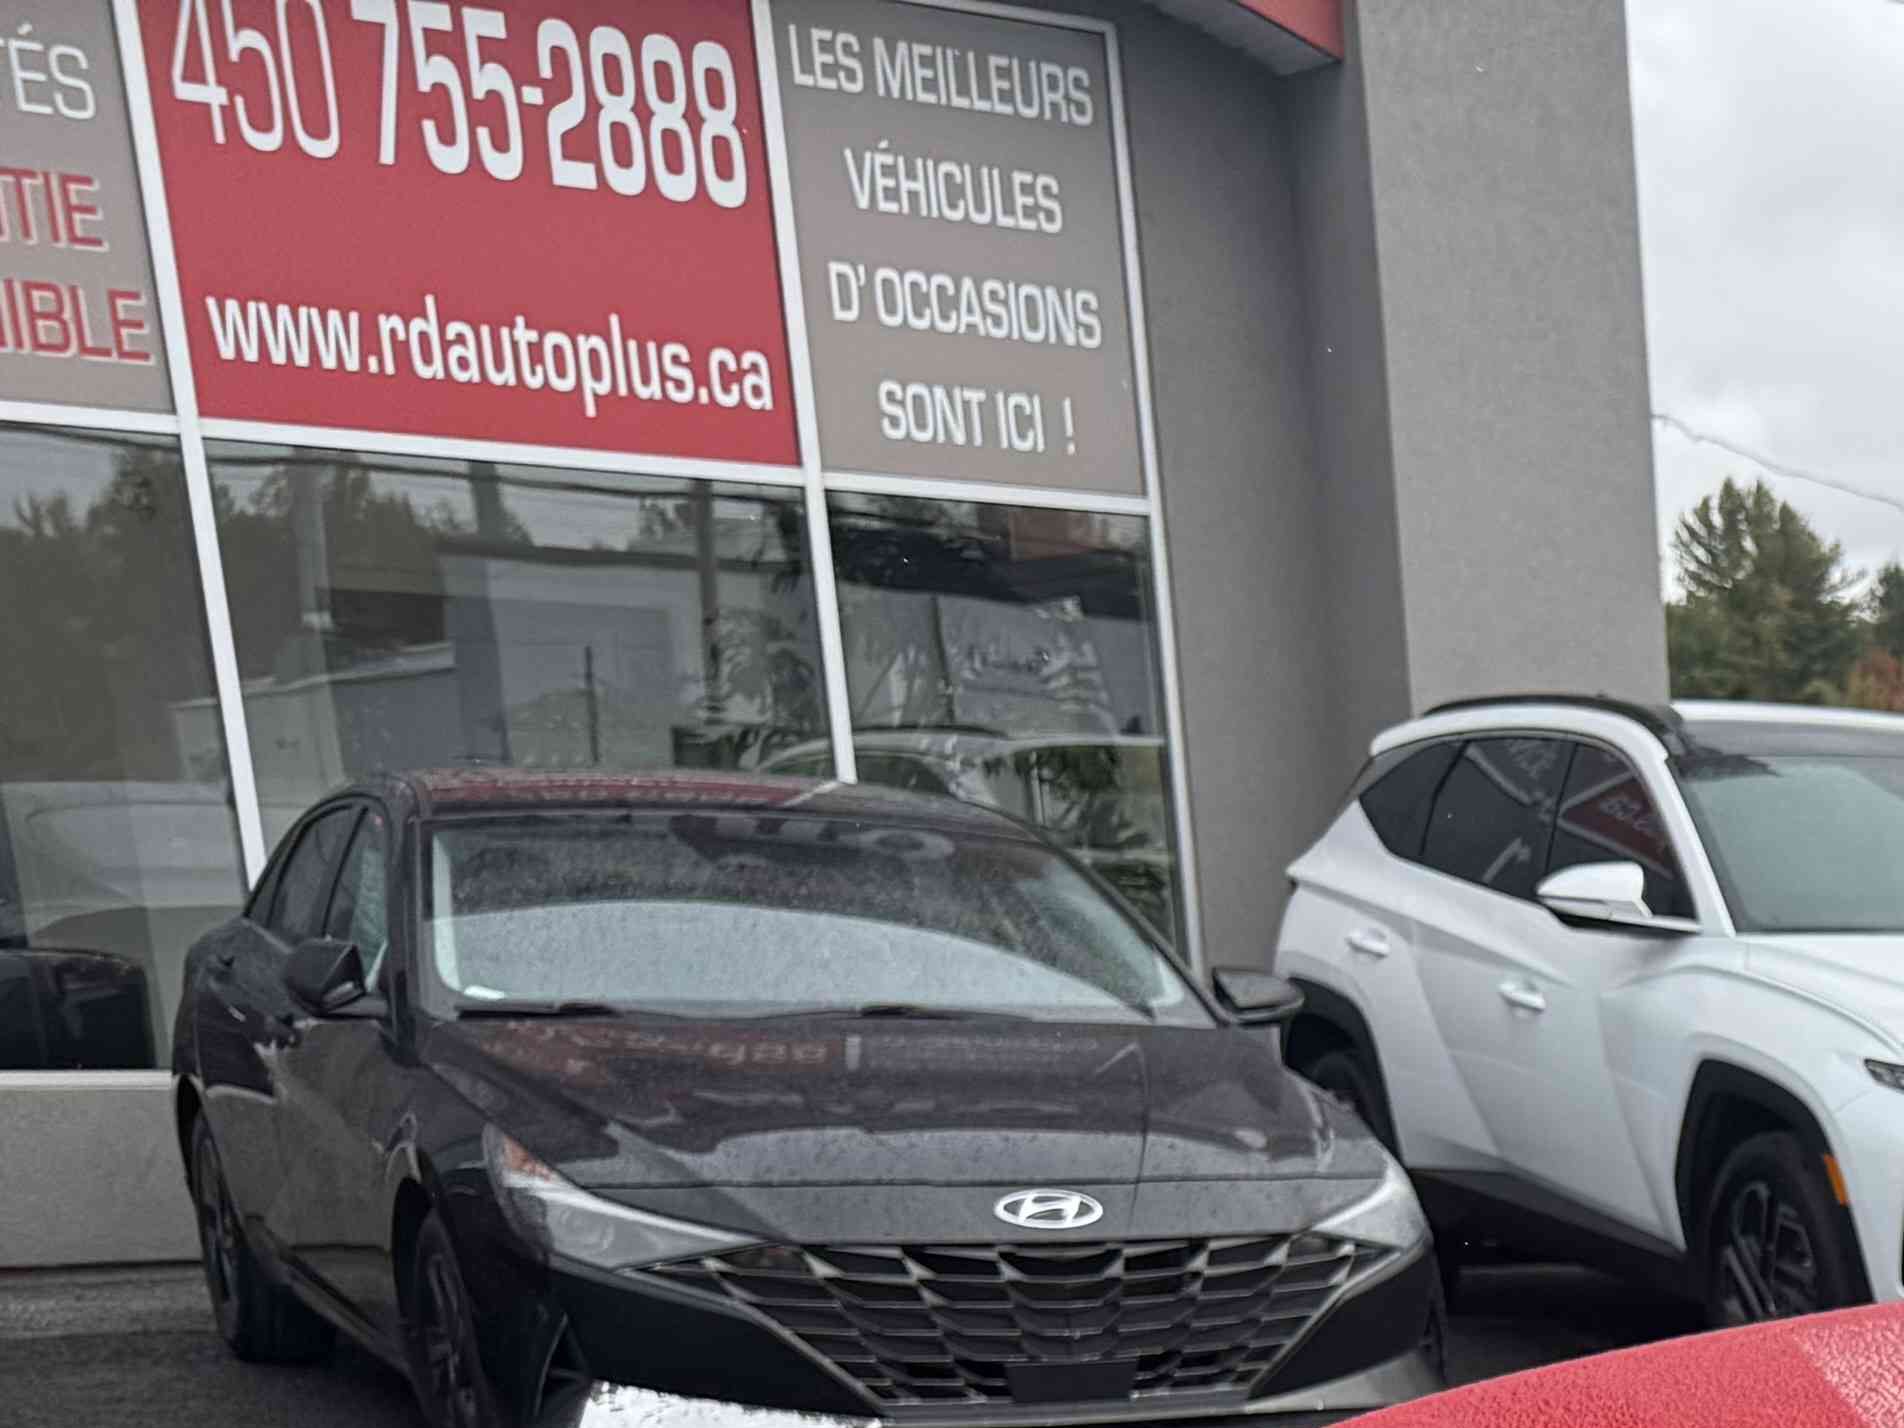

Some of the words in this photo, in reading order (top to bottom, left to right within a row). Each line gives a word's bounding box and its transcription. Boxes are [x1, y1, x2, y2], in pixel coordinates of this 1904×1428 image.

[0, 22, 96, 120] ÉS
[171, 0, 340, 159] 450
[350, 0, 748, 208] 755-2888
[788, 24, 864, 93] LES
[872, 37, 1093, 126] MEILLEURS
[0, 165, 108, 252] TIE
[843, 139, 1063, 234] VÉHICULES
[0, 277, 155, 365] IBLE
[205, 294, 775, 418] www.rdautoplus.ca
[878, 380, 986, 446] SONT
[997, 391, 1045, 453] ICI
